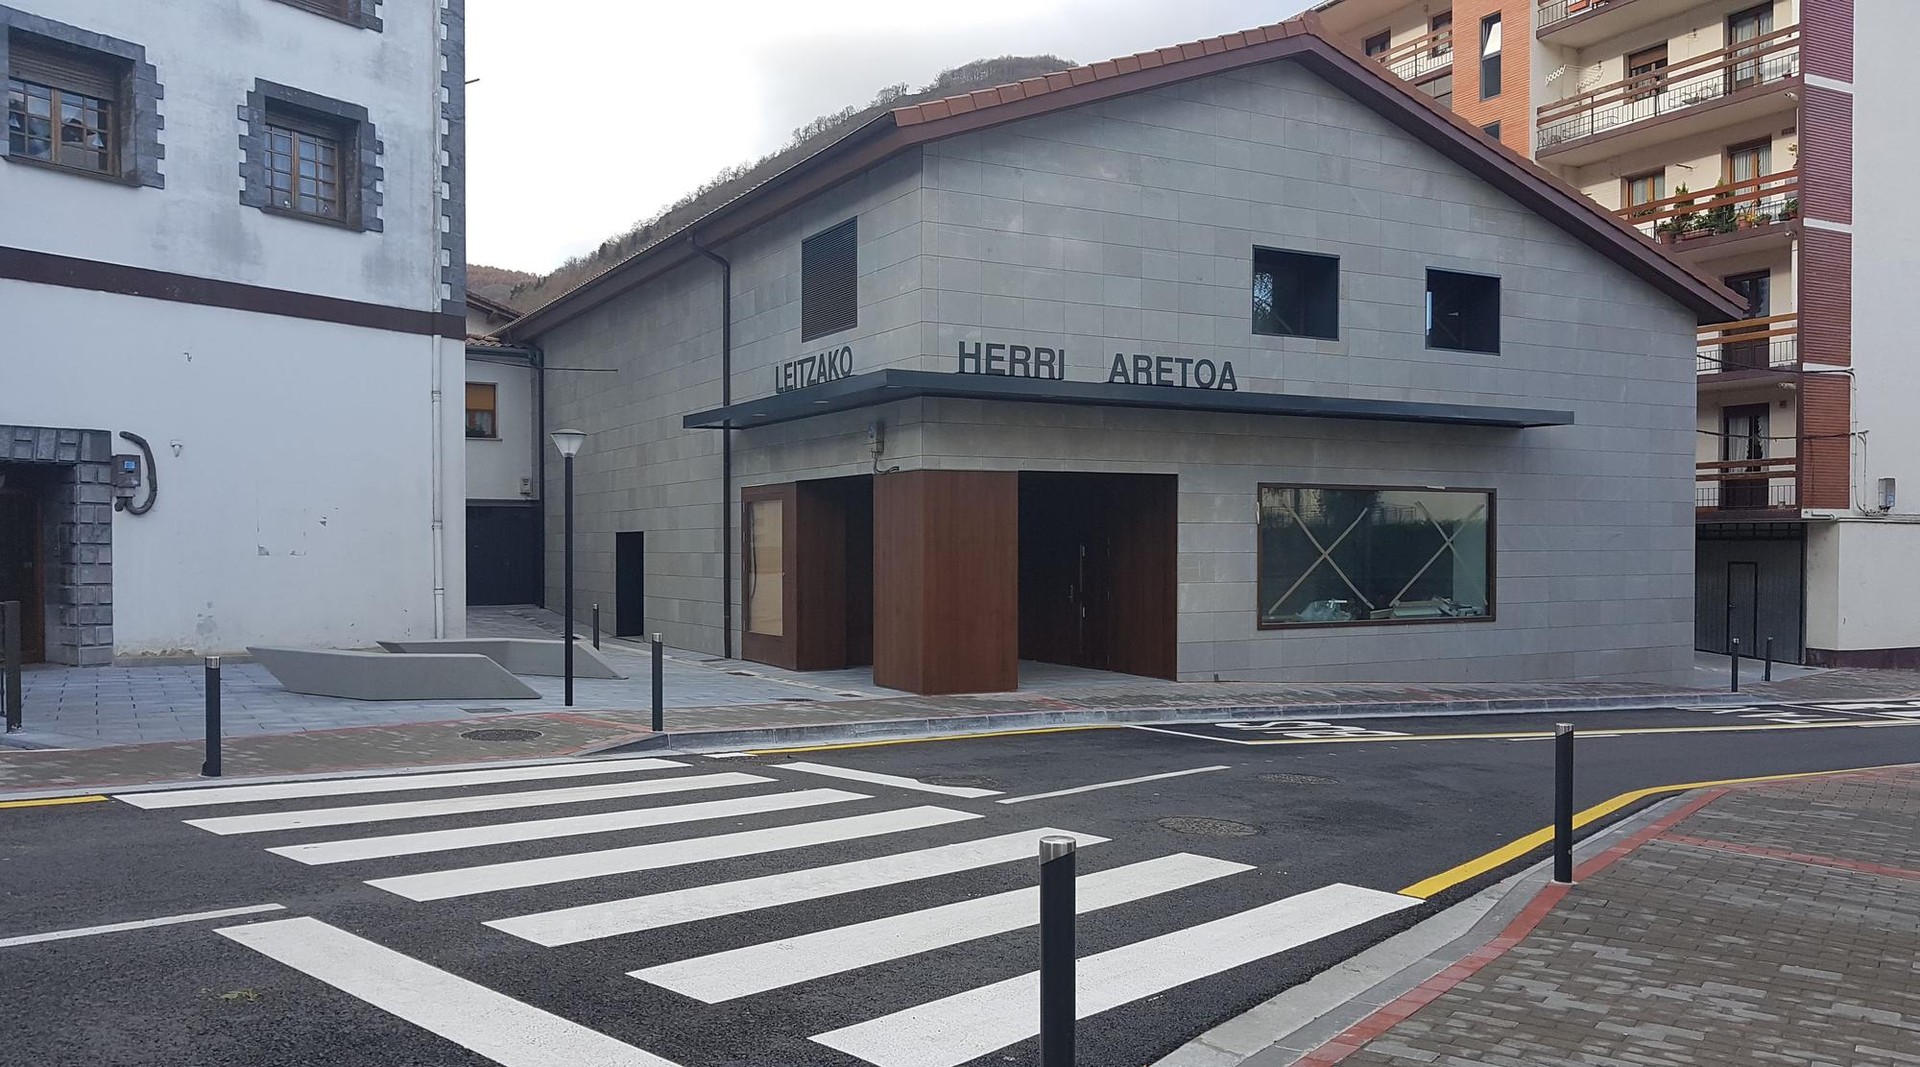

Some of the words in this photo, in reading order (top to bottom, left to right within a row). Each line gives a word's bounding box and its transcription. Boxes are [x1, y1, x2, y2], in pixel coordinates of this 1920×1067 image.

[776, 346, 852, 394] LEITZAKO
[958, 341, 1065, 380] HERRI
[1109, 353, 1238, 391] ARETOA
[1214, 720, 1414, 739] BUS
